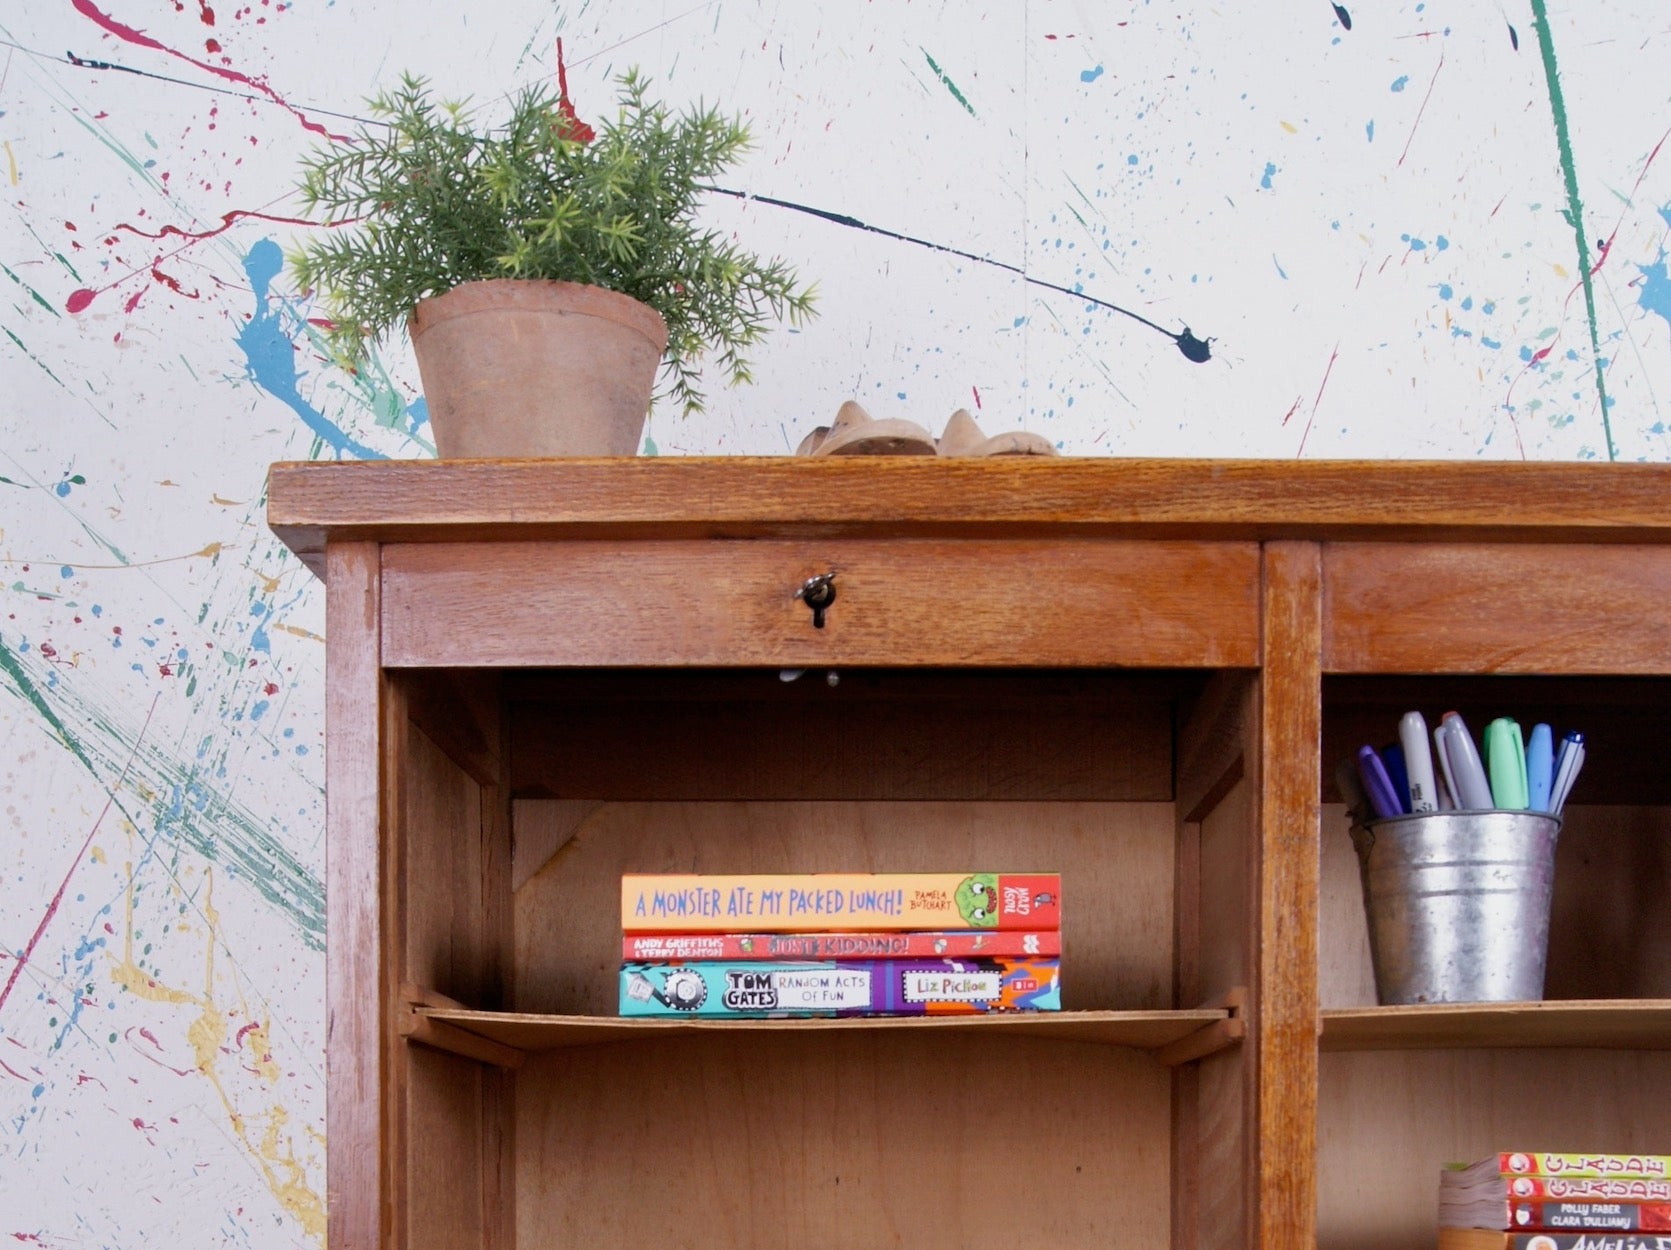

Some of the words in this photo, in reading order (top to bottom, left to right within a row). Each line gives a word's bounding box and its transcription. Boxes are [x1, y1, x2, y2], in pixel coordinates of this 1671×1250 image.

[635, 890, 647, 917] A
[651, 886, 721, 918] MONSTER
[727, 886, 754, 917] ATE
[759, 888, 783, 916] MY
[788, 888, 844, 916] PACKED
[849, 888, 903, 916] LUNCH!
[914, 890, 947, 900] PAMELA
[1003, 886, 1018, 914] nosy
[910, 900, 952, 910] BUTCHART
[633, 938, 663, 949] ANDY
[665, 938, 725, 949] GRIFFITHS
[640, 949, 675, 958] TERRY
[676, 948, 723, 957] DENTON
[729, 973, 772, 990] TOM
[835, 976, 866, 988] ACTS
[917, 978, 938, 993] Liz
[727, 991, 775, 1006] GATES
[1544, 1154, 1665, 1175] CLAUDE
[1549, 1178, 1669, 1198] CLAUDE
[1561, 1203, 1590, 1216] POLLY
[1592, 1203, 1621, 1214] FABER
[1551, 1216, 1580, 1227] CLARA
